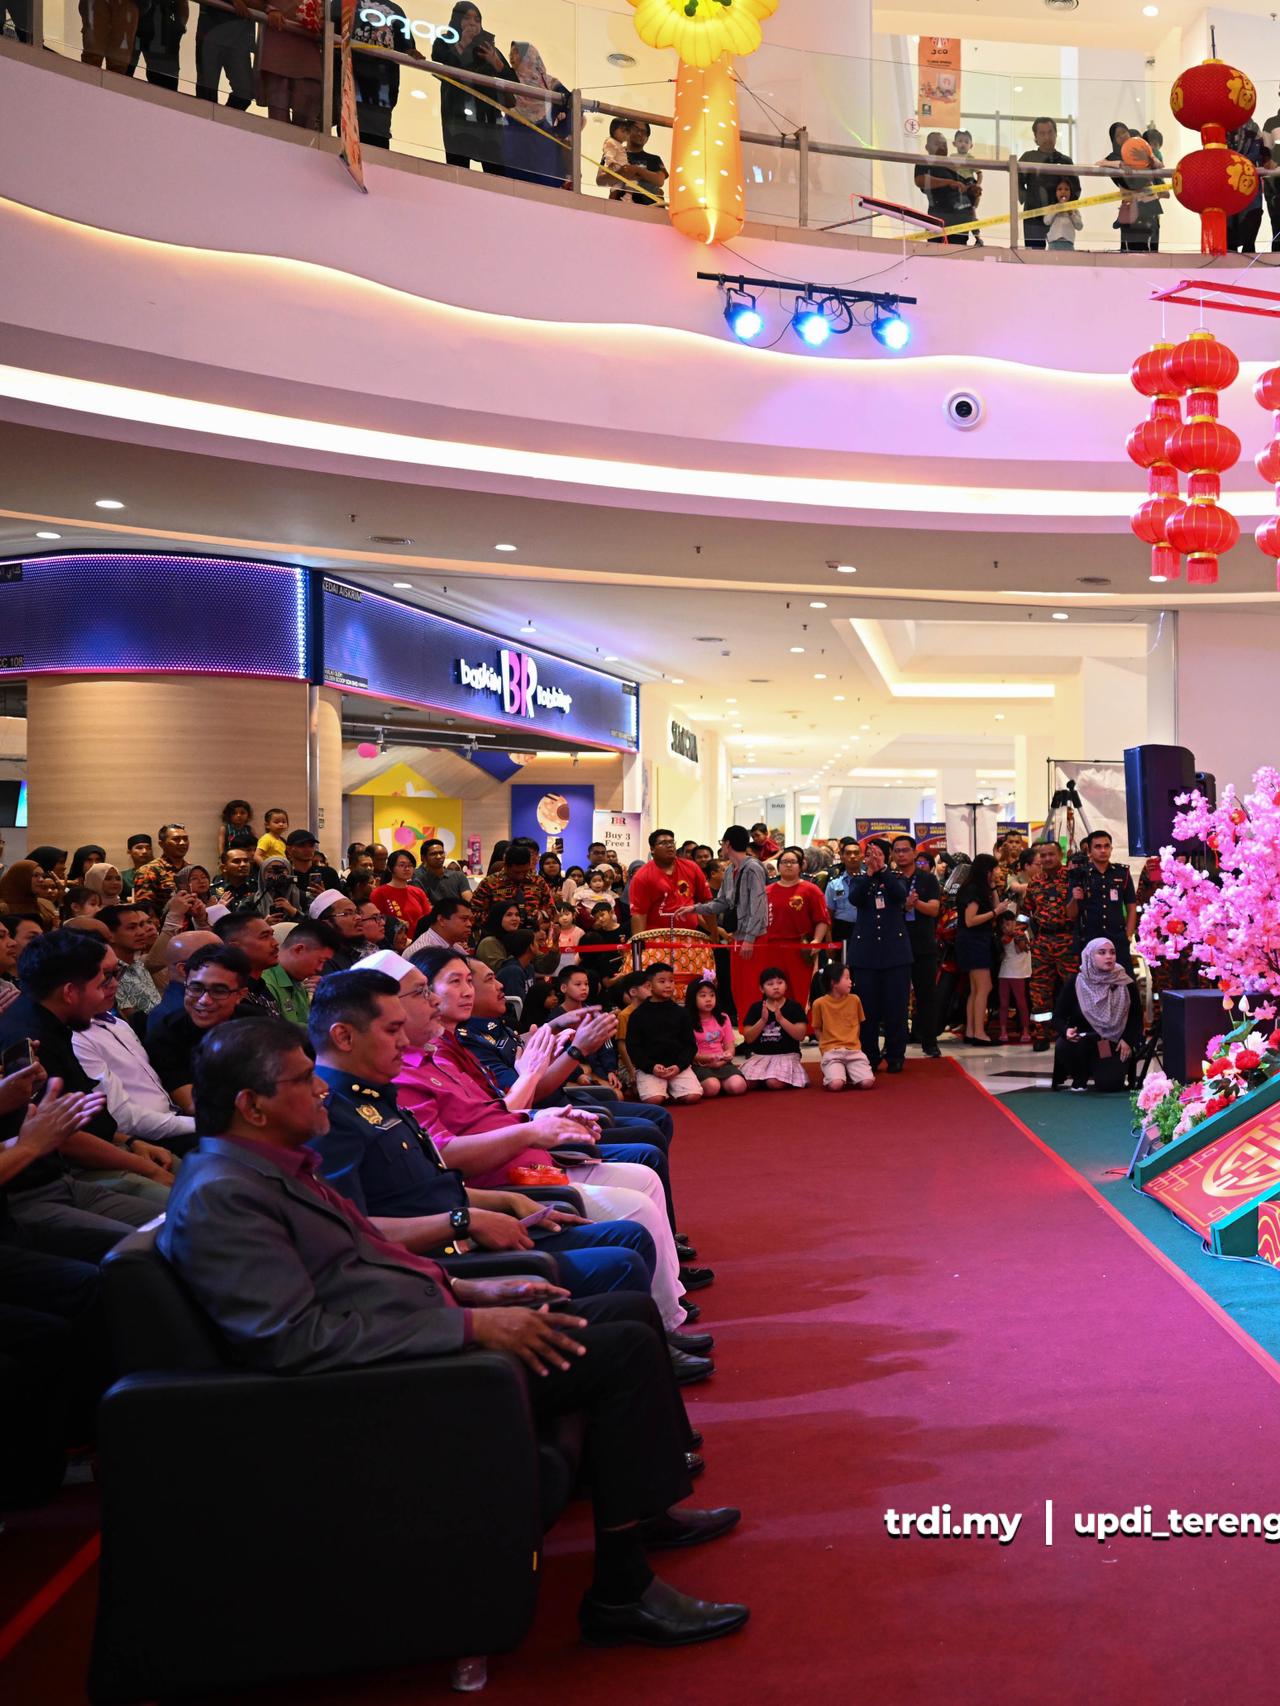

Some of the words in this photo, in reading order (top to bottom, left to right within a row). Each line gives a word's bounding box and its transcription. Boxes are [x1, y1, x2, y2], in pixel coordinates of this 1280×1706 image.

[501, 650, 538, 719] BR
[605, 831, 622, 840] Buy
[625, 832, 631, 840] 3
[605, 839, 624, 847] Free
